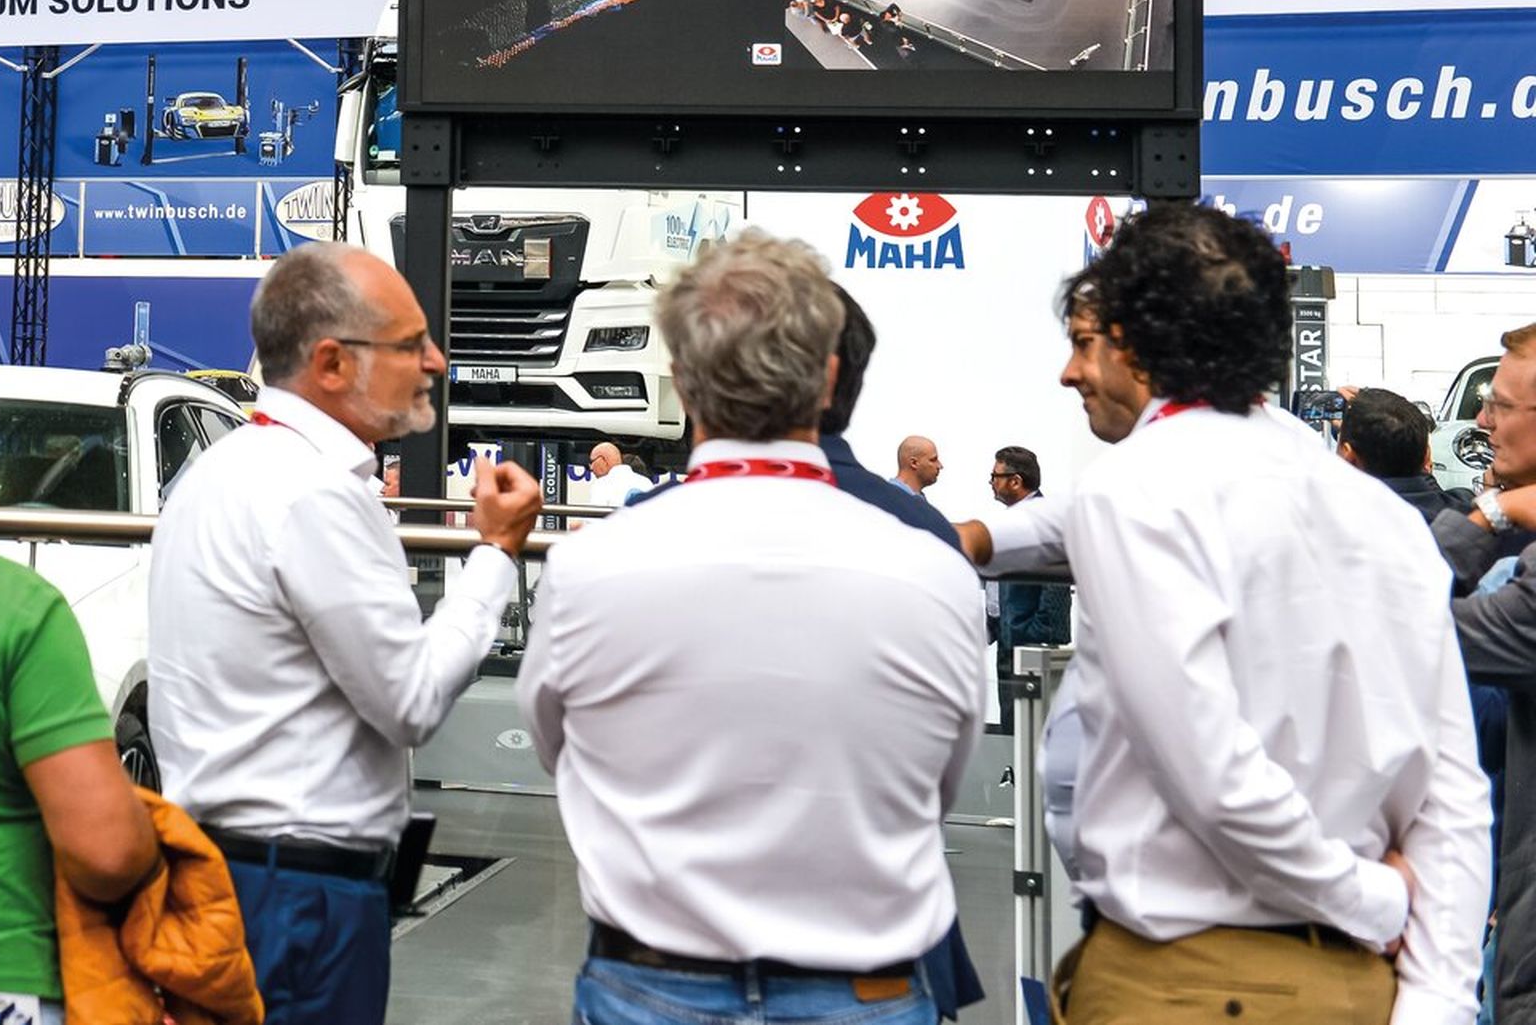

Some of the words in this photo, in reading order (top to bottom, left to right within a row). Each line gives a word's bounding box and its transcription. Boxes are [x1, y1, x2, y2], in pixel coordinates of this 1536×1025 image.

[284, 184, 334, 220] TWIN
[94, 204, 248, 220] www.twinbusch.de
[844, 222, 965, 269] MAHA
[451, 248, 524, 267] MAN
[471, 368, 500, 380] MAHA
